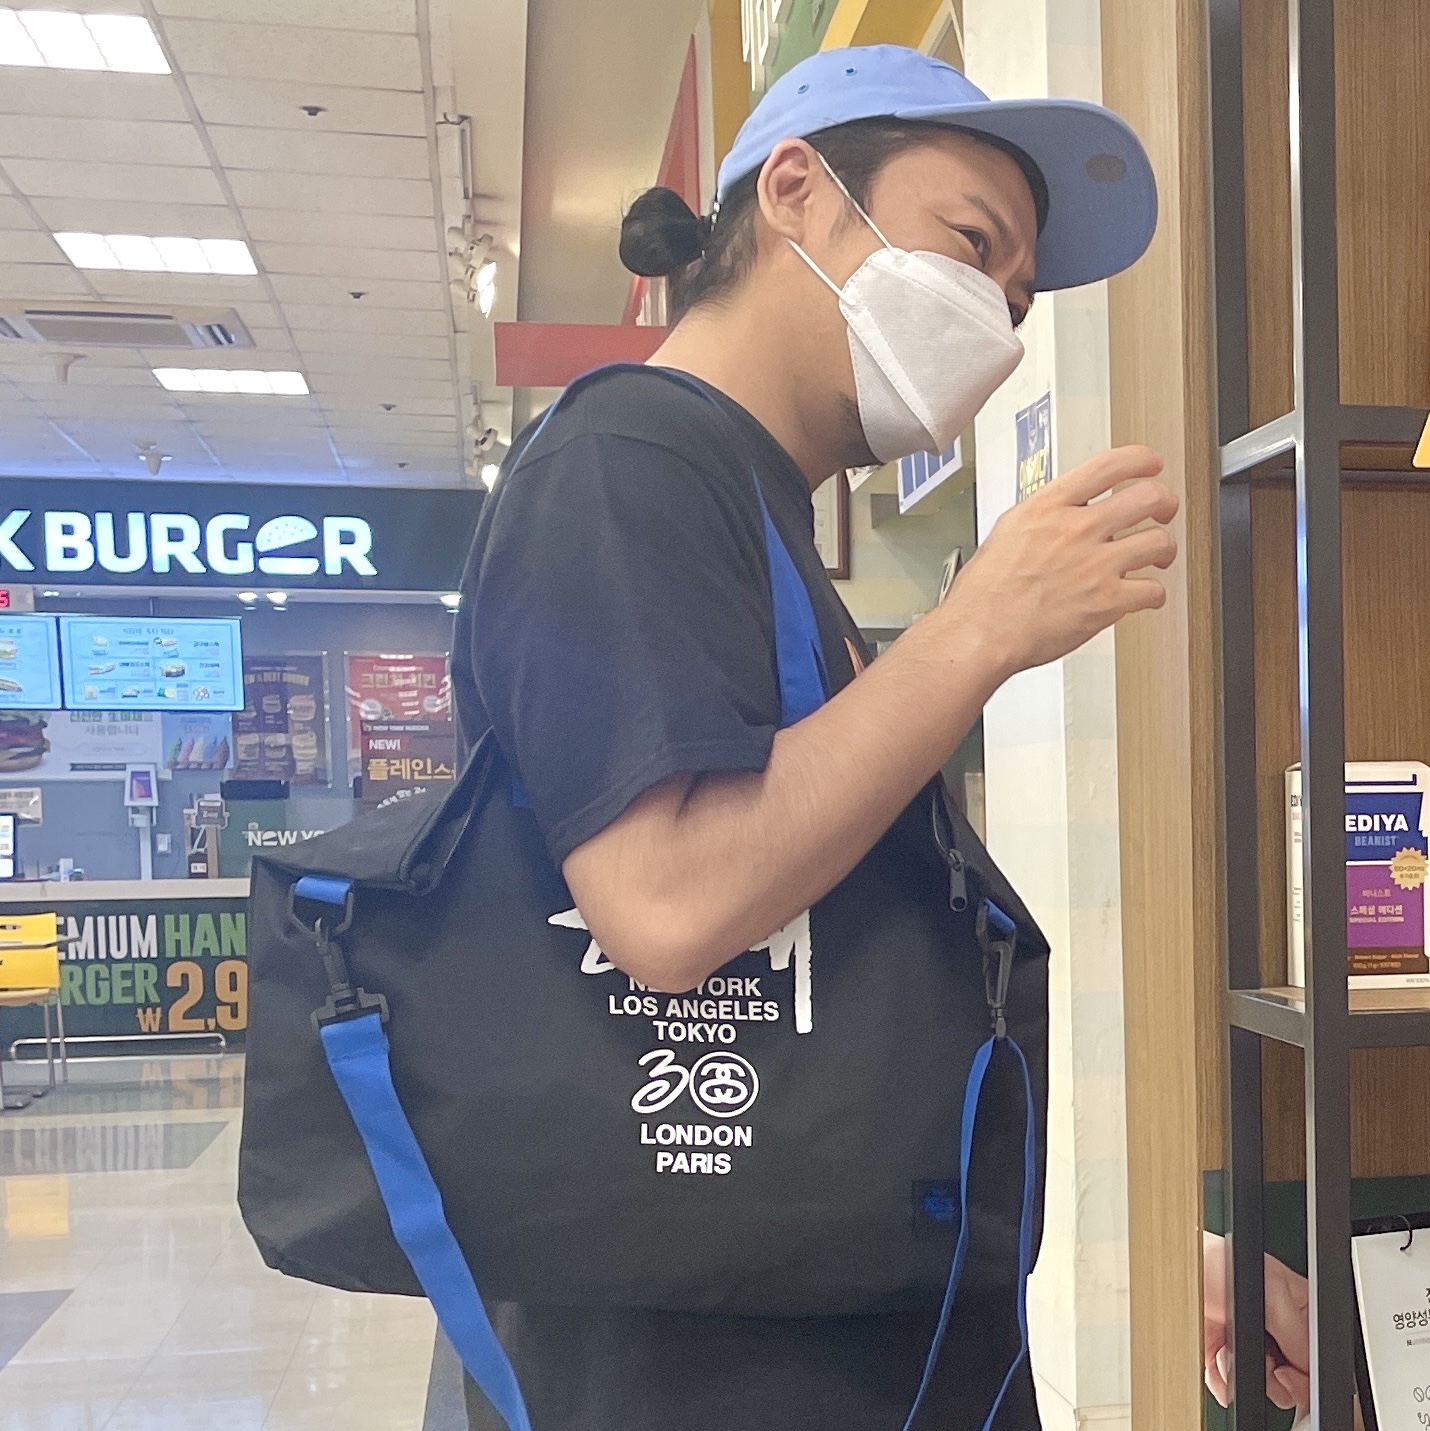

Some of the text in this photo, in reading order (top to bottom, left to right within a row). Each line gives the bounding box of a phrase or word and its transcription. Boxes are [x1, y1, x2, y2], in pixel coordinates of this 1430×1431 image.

[46, 511, 378, 576] BURGER
[369, 739, 401, 751] NEW!
[368, 758, 457, 781] 플레인스
[1345, 814, 1409, 832] EDIYA
[1354, 836, 1397, 847] BEANIST
[1350, 905, 1376, 915] 스페셜
[164, 912, 247, 958] HAN
[58, 962, 161, 1006] RGER
[609, 995, 779, 1021] LOS ANGELES
[652, 1020, 736, 1043] TOKYO
[640, 1123, 752, 1147] LONDON
[656, 1151, 732, 1174] PARIS
